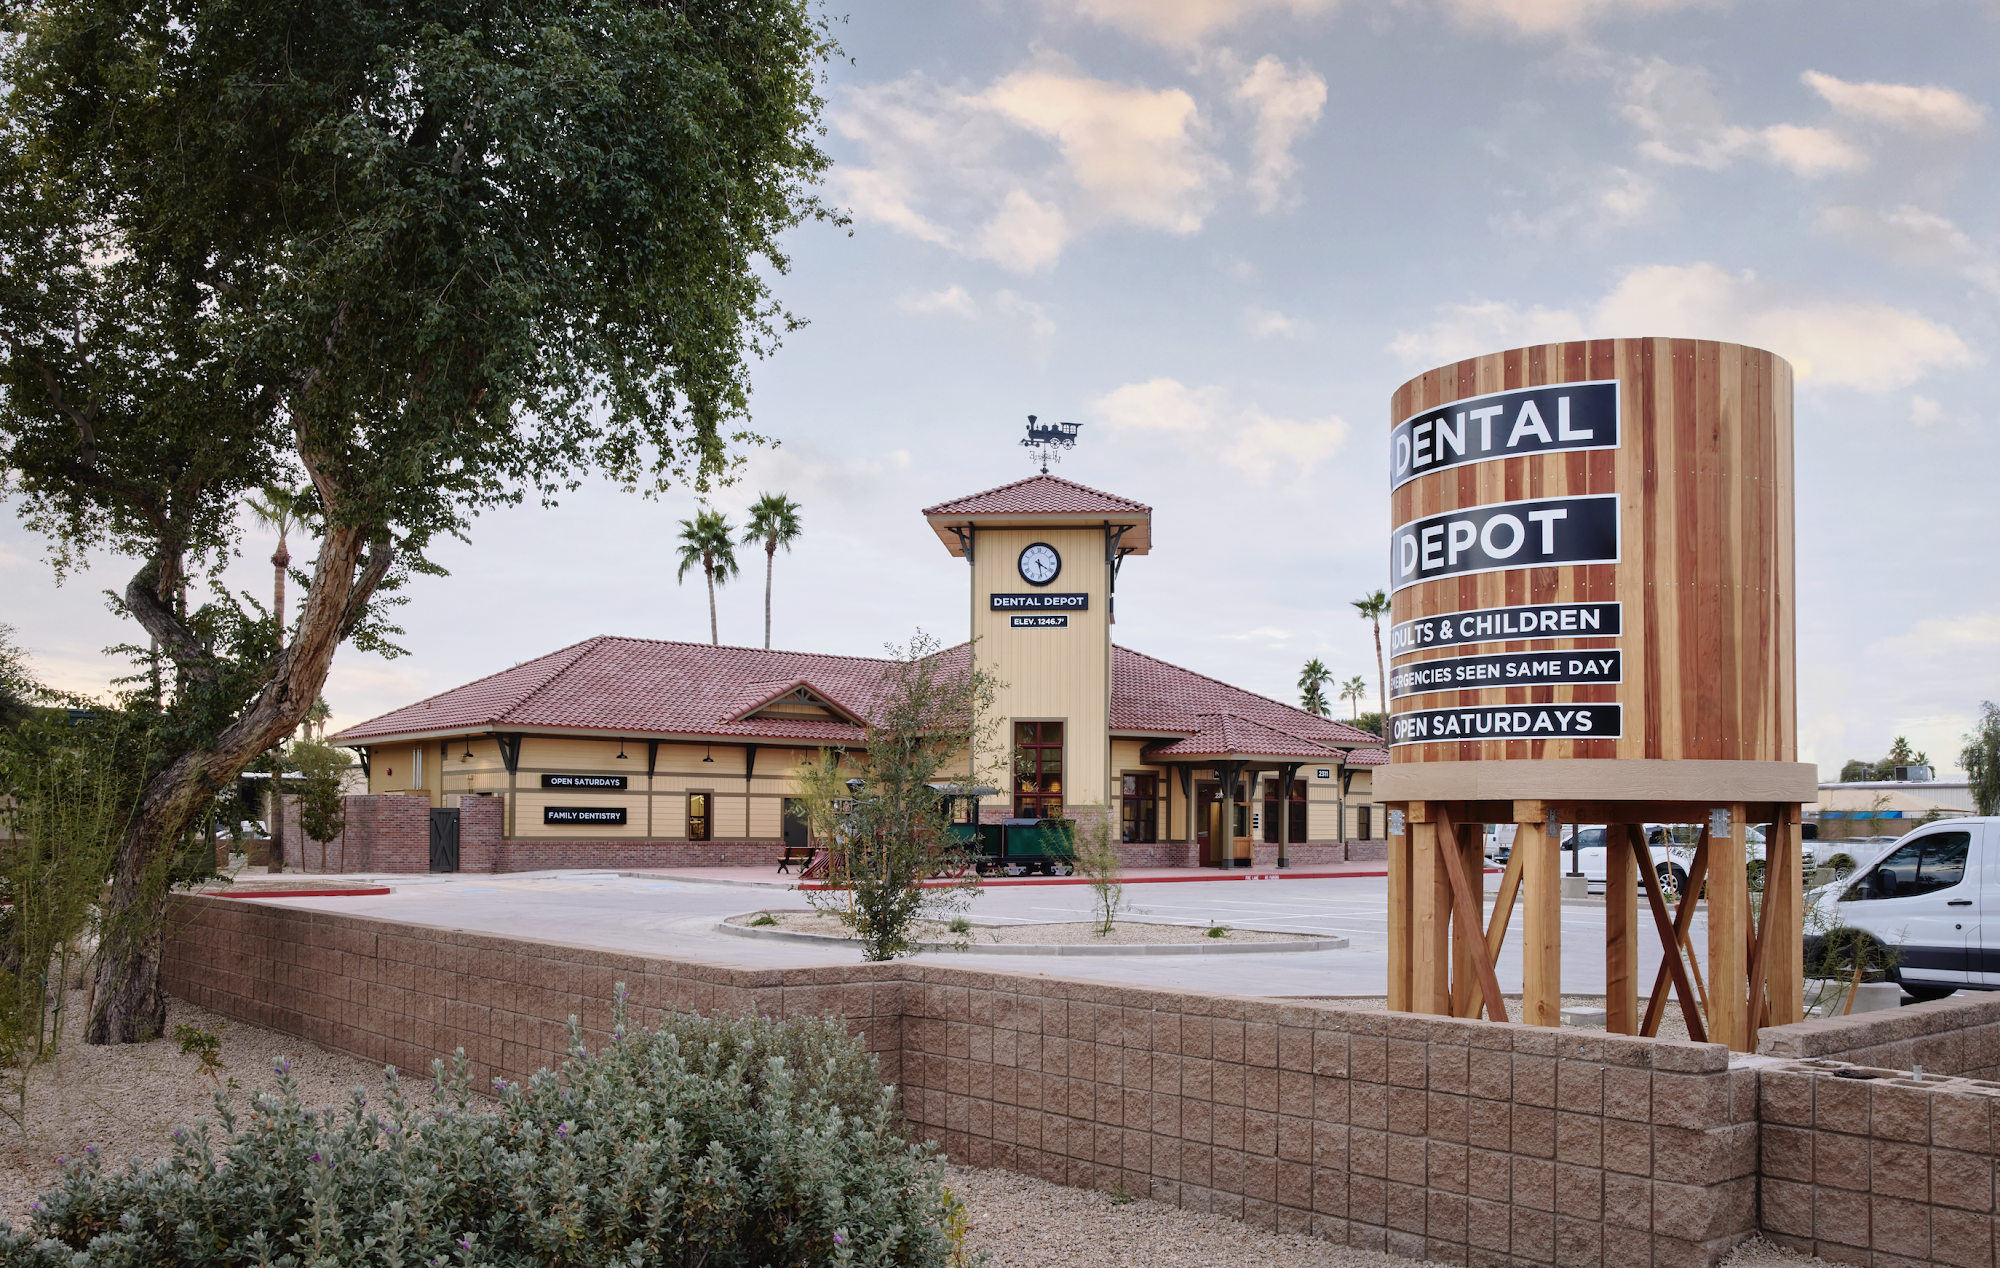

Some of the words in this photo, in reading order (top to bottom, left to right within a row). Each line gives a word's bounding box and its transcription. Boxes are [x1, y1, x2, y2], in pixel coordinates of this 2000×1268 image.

[1396, 396, 1594, 478] DENTAL
[1400, 508, 1568, 578] DEPOT
[993, 597, 1041, 606] DENTAL
[1044, 597, 1084, 606] DEPOT
[1439, 619, 1454, 639] &
[1459, 608, 1600, 637] CHILDREN
[1456, 663, 1500, 681] SEEN
[1505, 660, 1562, 678] SAME
[1568, 659, 1614, 675] DAY
[1394, 716, 1428, 740] OPEN
[1432, 710, 1593, 736] SATURDAYS
[551, 777, 572, 785] OPEN
[574, 778, 620, 786] SATURDAYS
[548, 811, 577, 819] FAMILY
[579, 812, 621, 820] DENTISTRY
